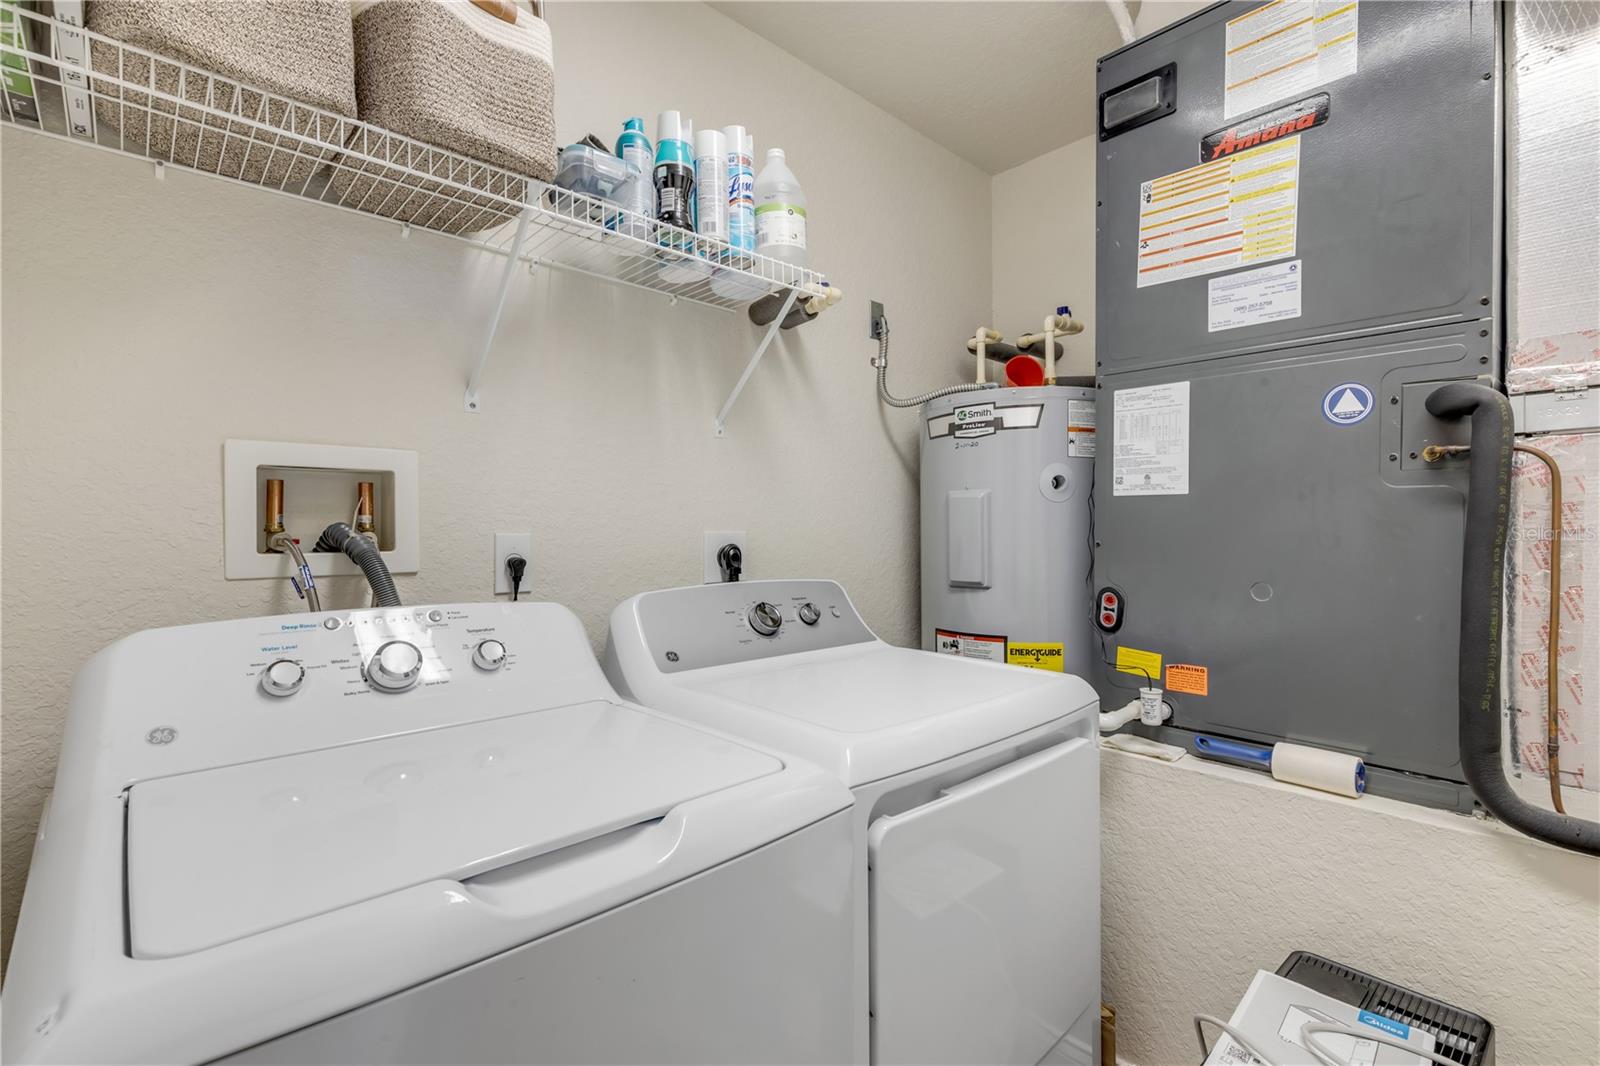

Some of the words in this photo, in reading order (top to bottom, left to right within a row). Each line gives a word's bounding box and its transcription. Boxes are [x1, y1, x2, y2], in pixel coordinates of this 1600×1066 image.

[1211, 111, 1318, 160] Amana
[728, 176, 753, 198] Lyso
[968, 409, 992, 419] Smith
[1168, 665, 1206, 674] WARNING
[1363, 1014, 1405, 1036] Midea
